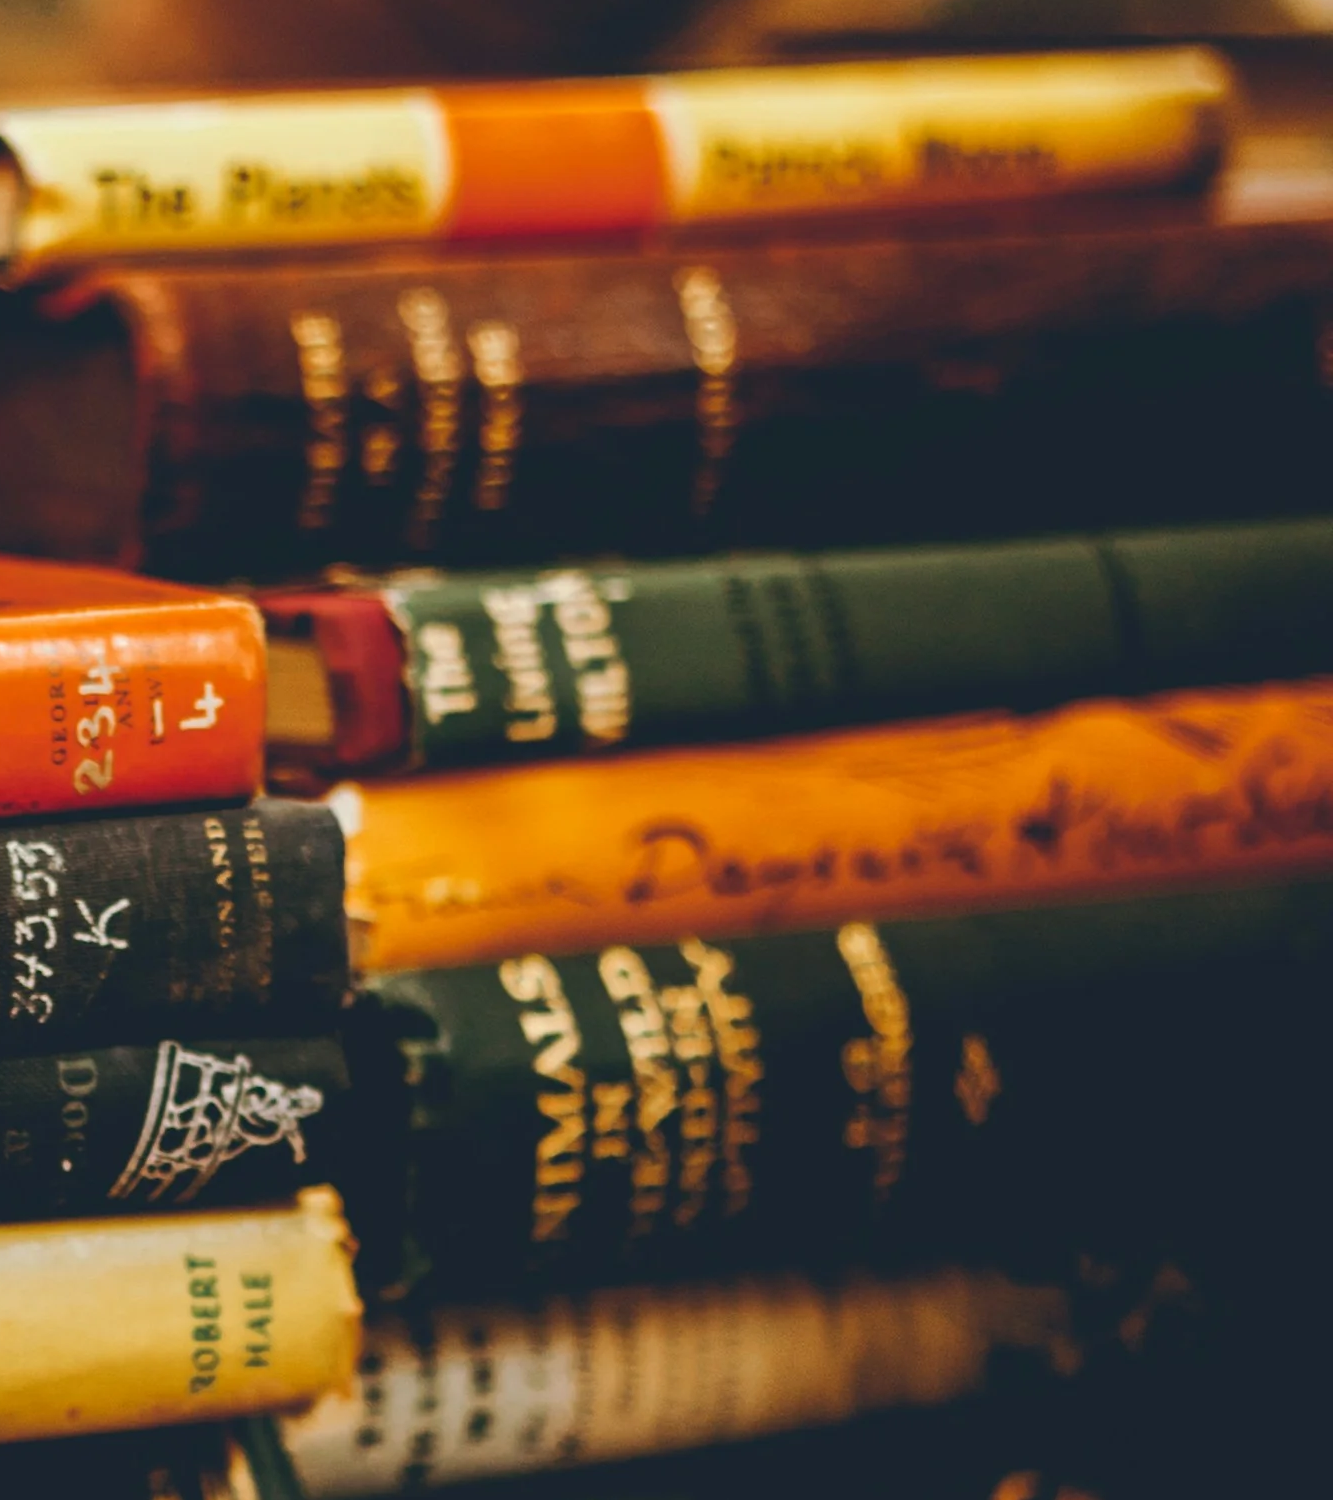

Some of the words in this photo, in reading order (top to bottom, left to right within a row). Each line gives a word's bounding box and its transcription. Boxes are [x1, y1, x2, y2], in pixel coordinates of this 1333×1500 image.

[7, 840, 68, 1024] 343.53
[73, 898, 130, 950] K
[497, 953, 587, 1245] NIMALS
[184, 1255, 218, 1394] ROBERT
[242, 1271, 272, 1367] HALE
